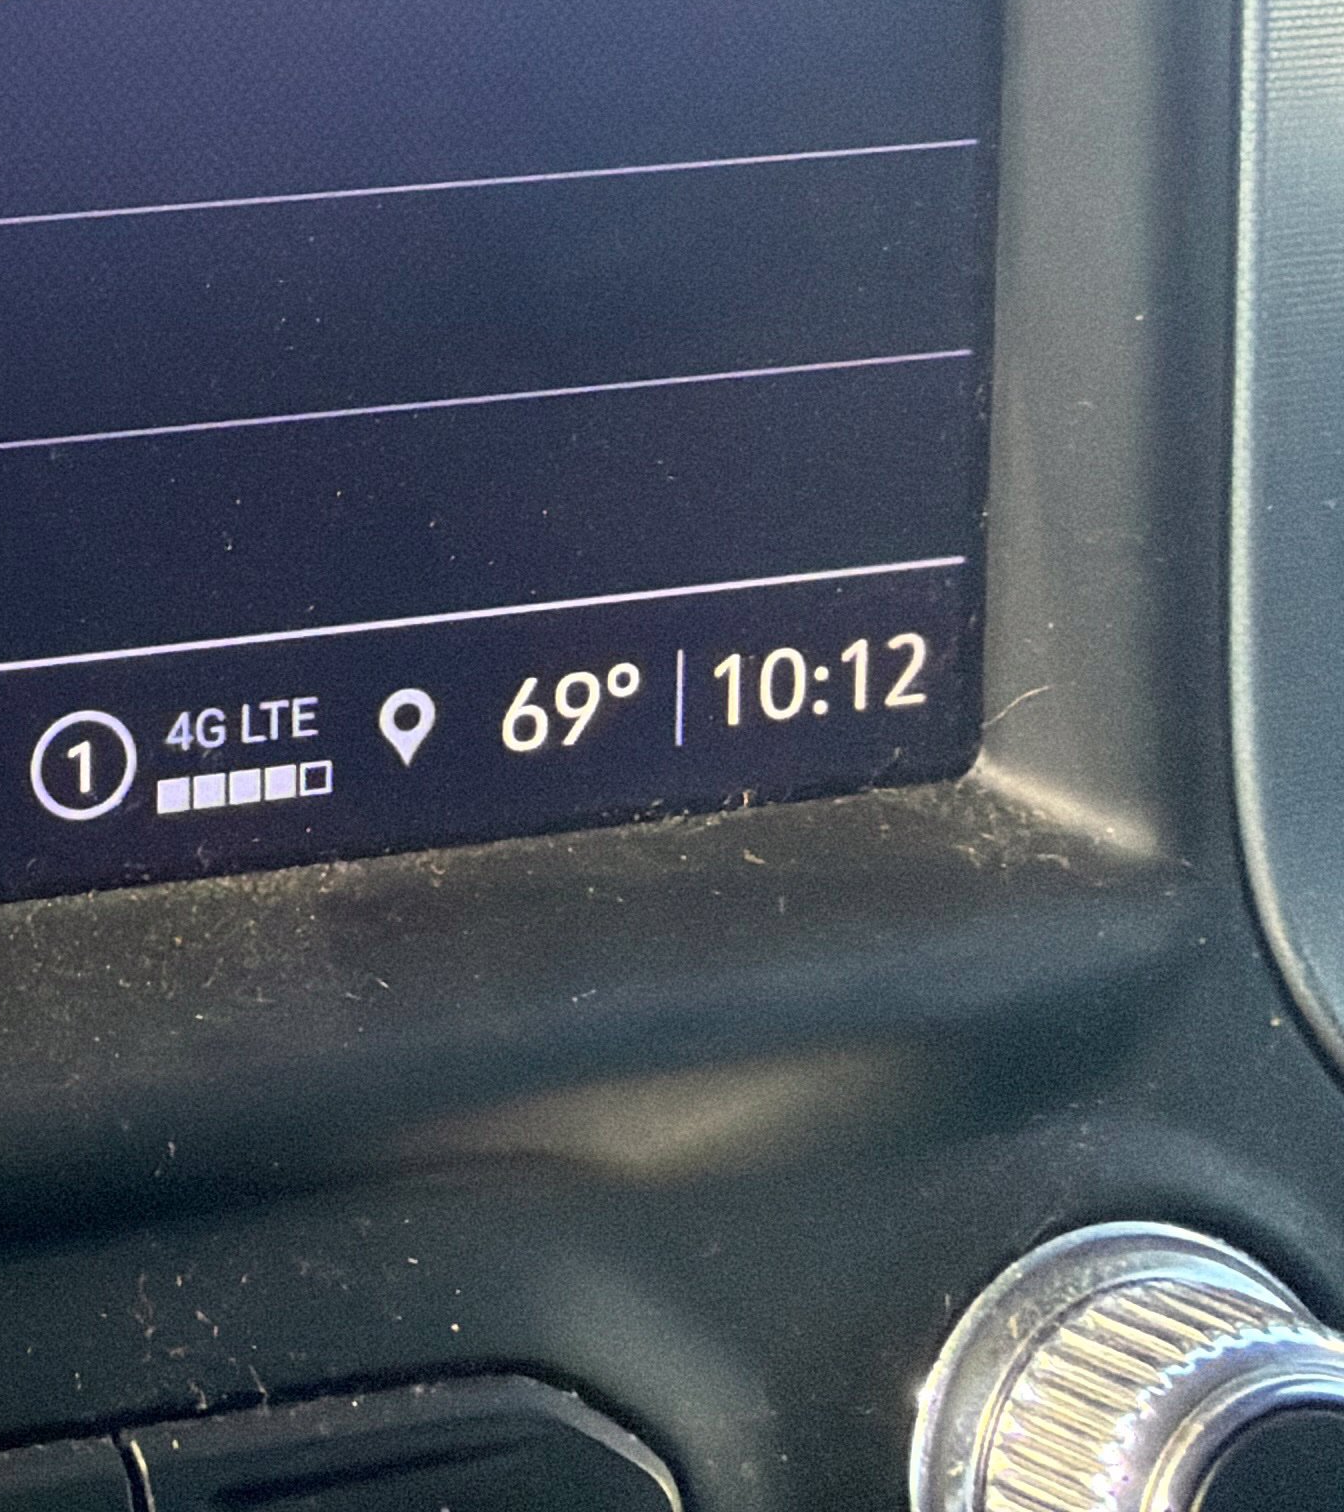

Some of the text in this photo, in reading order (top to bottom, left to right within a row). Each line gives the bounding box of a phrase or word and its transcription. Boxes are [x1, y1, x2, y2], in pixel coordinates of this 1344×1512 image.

[711, 630, 929, 728] 10:12
[164, 694, 321, 753] 4G LTE
[67, 739, 92, 794] 1
